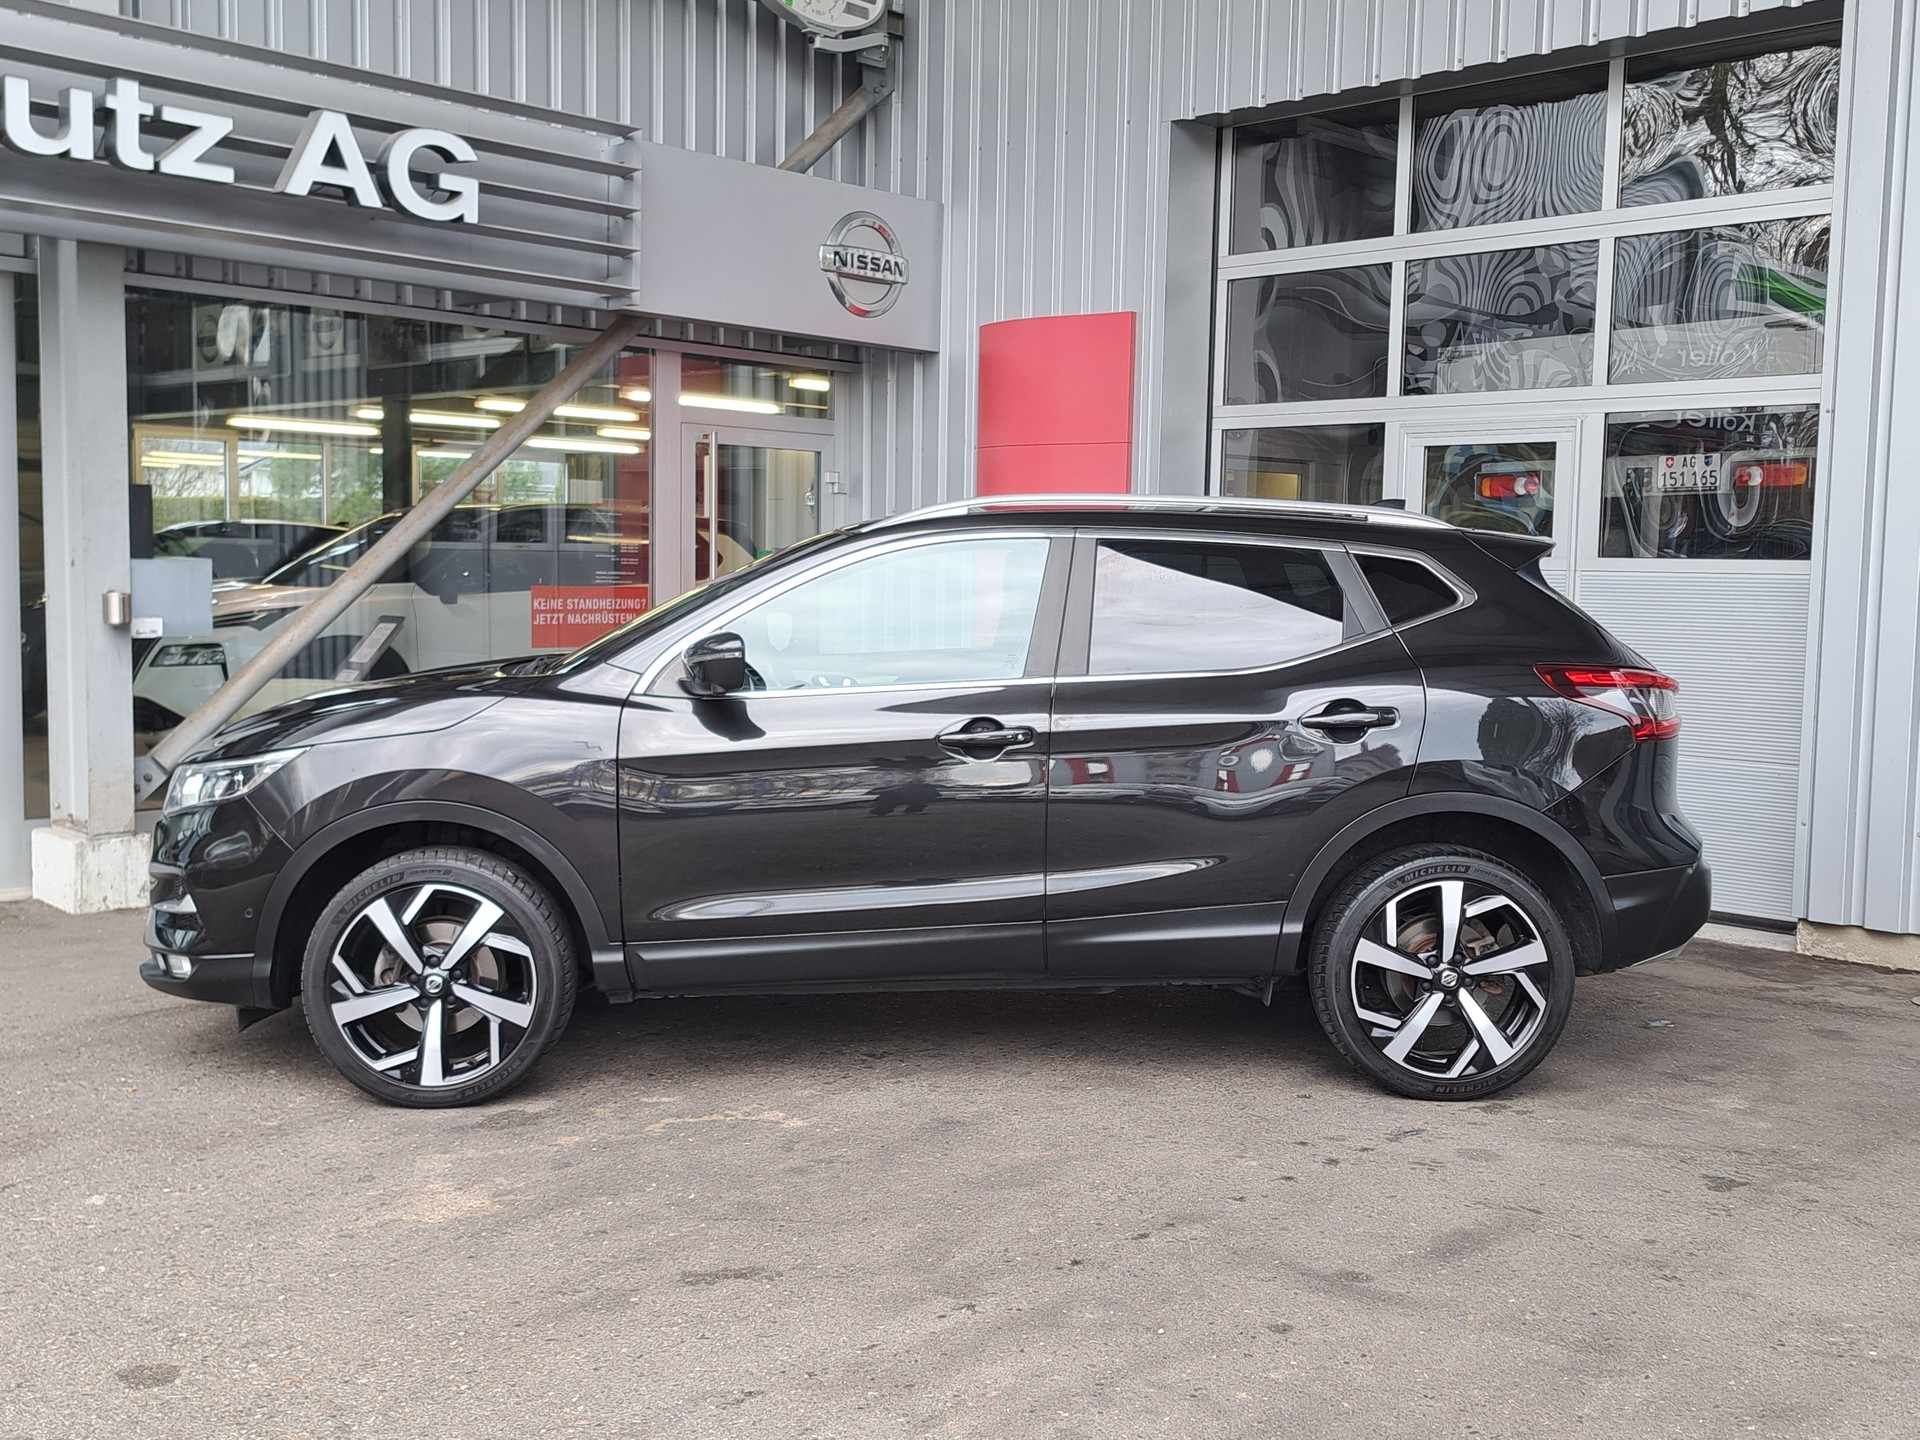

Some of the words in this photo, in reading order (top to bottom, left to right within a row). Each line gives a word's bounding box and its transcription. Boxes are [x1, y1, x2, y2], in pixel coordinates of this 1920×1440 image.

[2, 74, 235, 184] utz
[275, 110, 479, 224] AG
[833, 250, 903, 277] NISSAN
[1682, 456, 1697, 468] AG
[1661, 471, 1686, 487] 151
[1691, 469, 1718, 486] 165
[533, 598, 564, 610] KEINE
[567, 598, 646, 610] STANDHEIZUNG?
[533, 613, 564, 625] JETZT
[1404, 865, 1467, 882] MICHELIN
[344, 872, 402, 912] MICHELIN
[1436, 1078, 1498, 1094] MICHELIN
